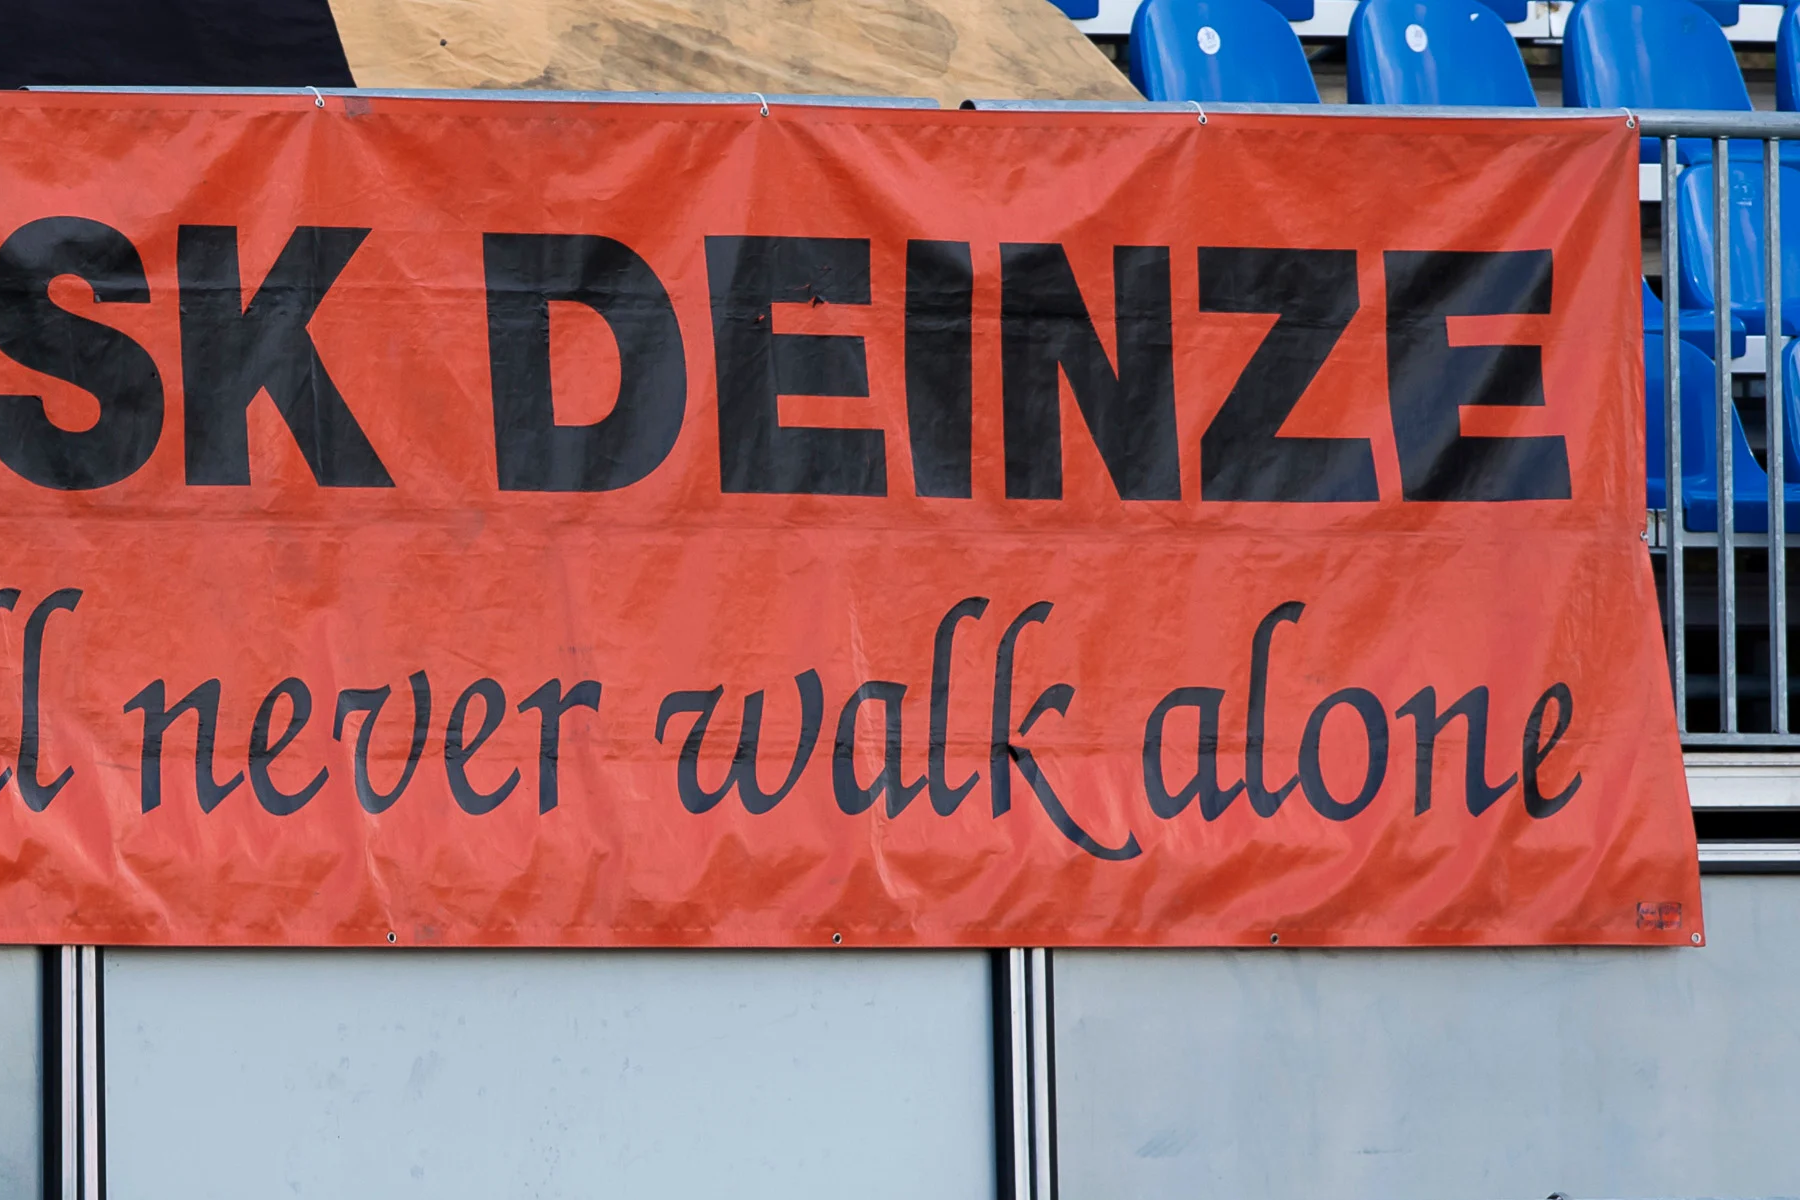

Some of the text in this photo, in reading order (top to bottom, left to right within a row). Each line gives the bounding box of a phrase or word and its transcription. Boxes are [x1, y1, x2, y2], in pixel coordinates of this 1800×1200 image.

[483, 232, 1572, 503] DEINZE
[124, 677, 601, 817] never
[655, 597, 1142, 861] walk
[1143, 601, 1582, 822] alone
